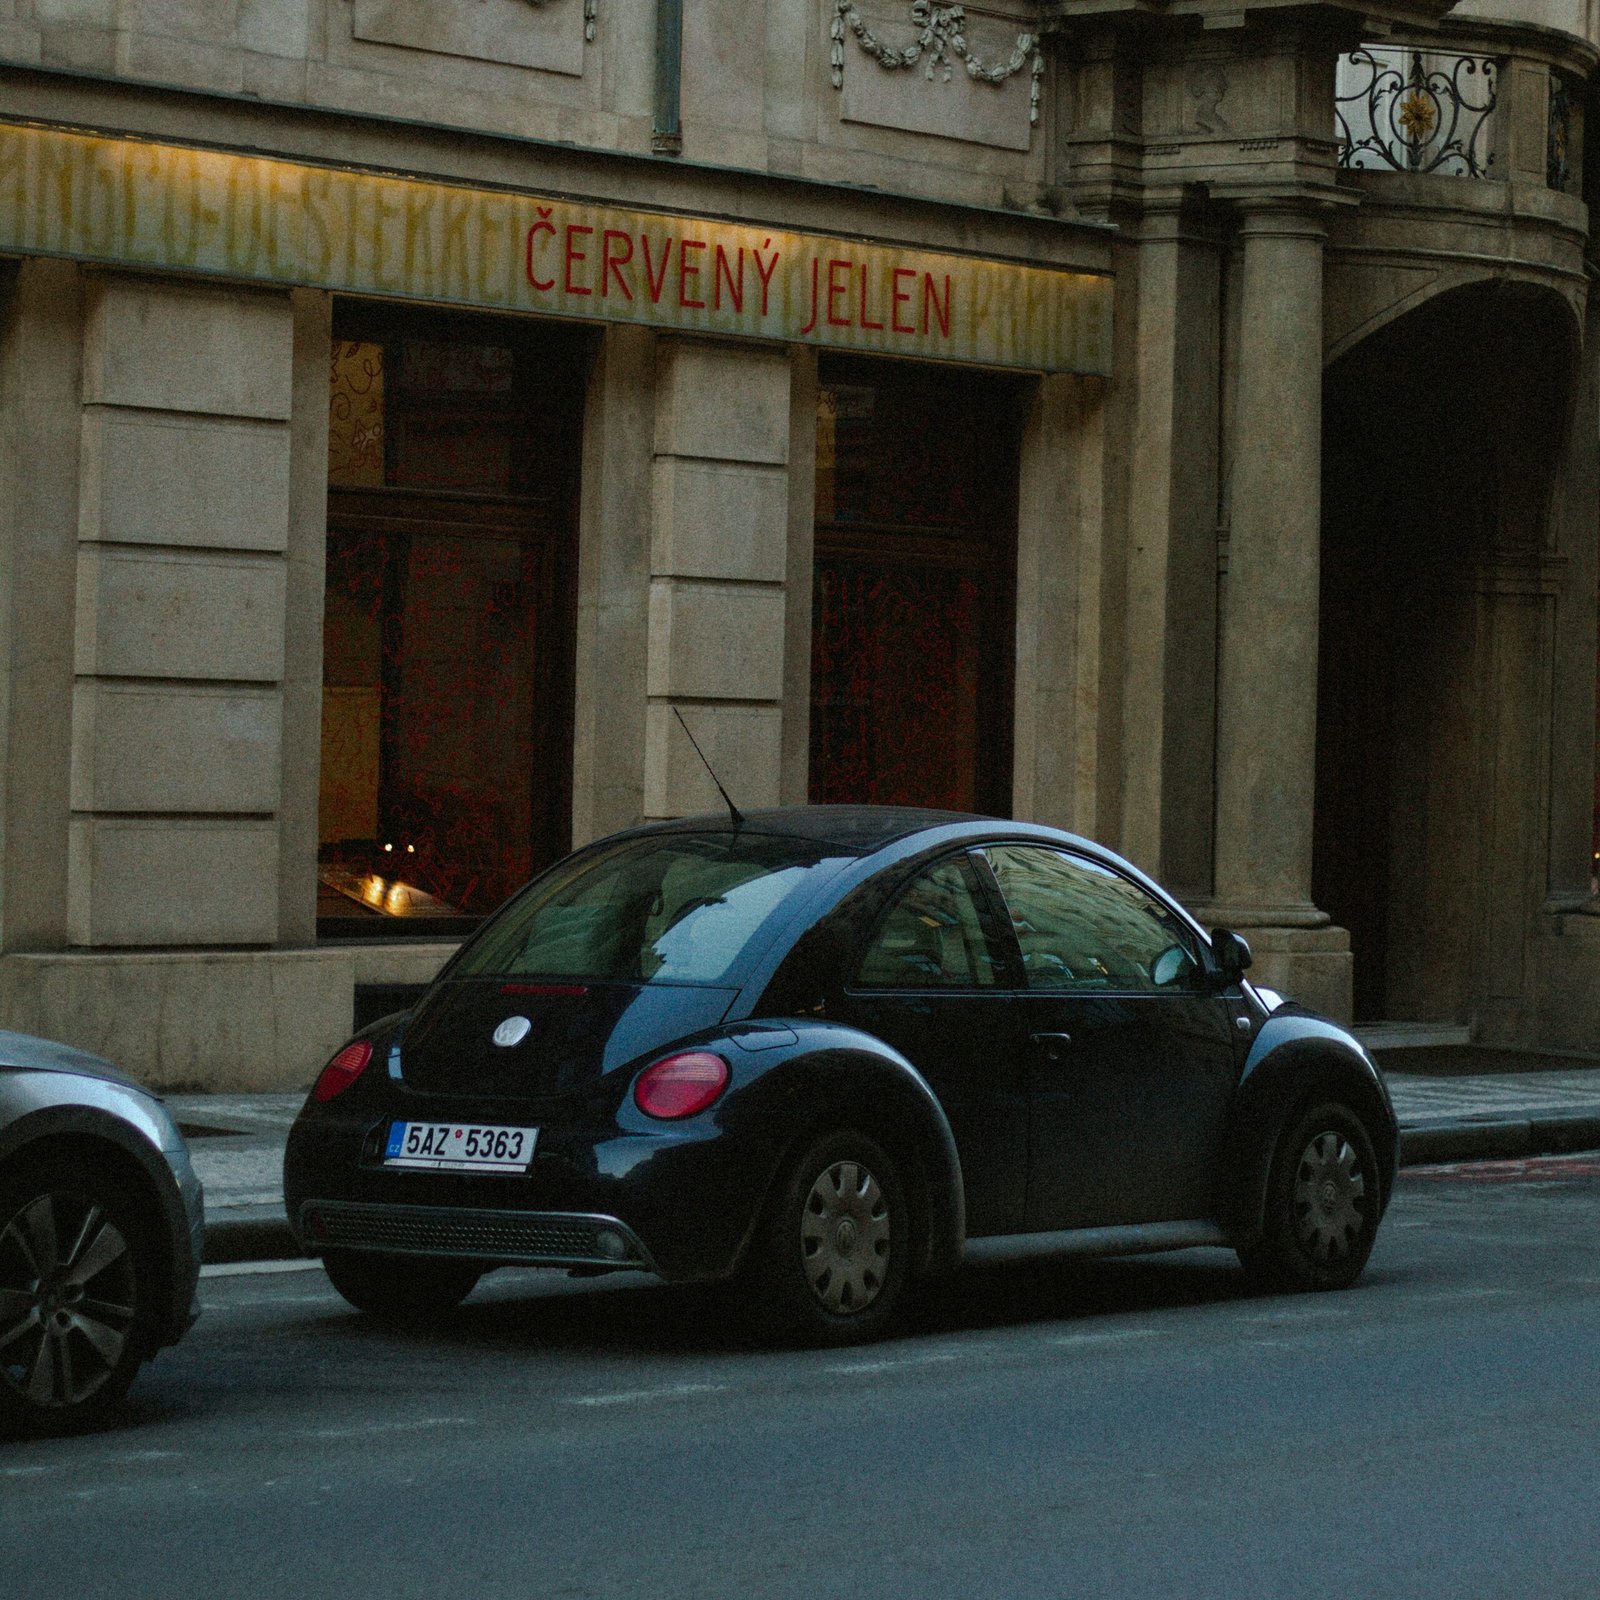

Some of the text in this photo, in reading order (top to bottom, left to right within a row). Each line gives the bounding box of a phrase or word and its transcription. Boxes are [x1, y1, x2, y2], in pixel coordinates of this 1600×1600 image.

[526, 206, 780, 317] ČERVENÝ
[801, 257, 951, 338] JELEN
[388, 1144, 400, 1153] CZ
[407, 1126, 524, 1159] 5AZ 5363
